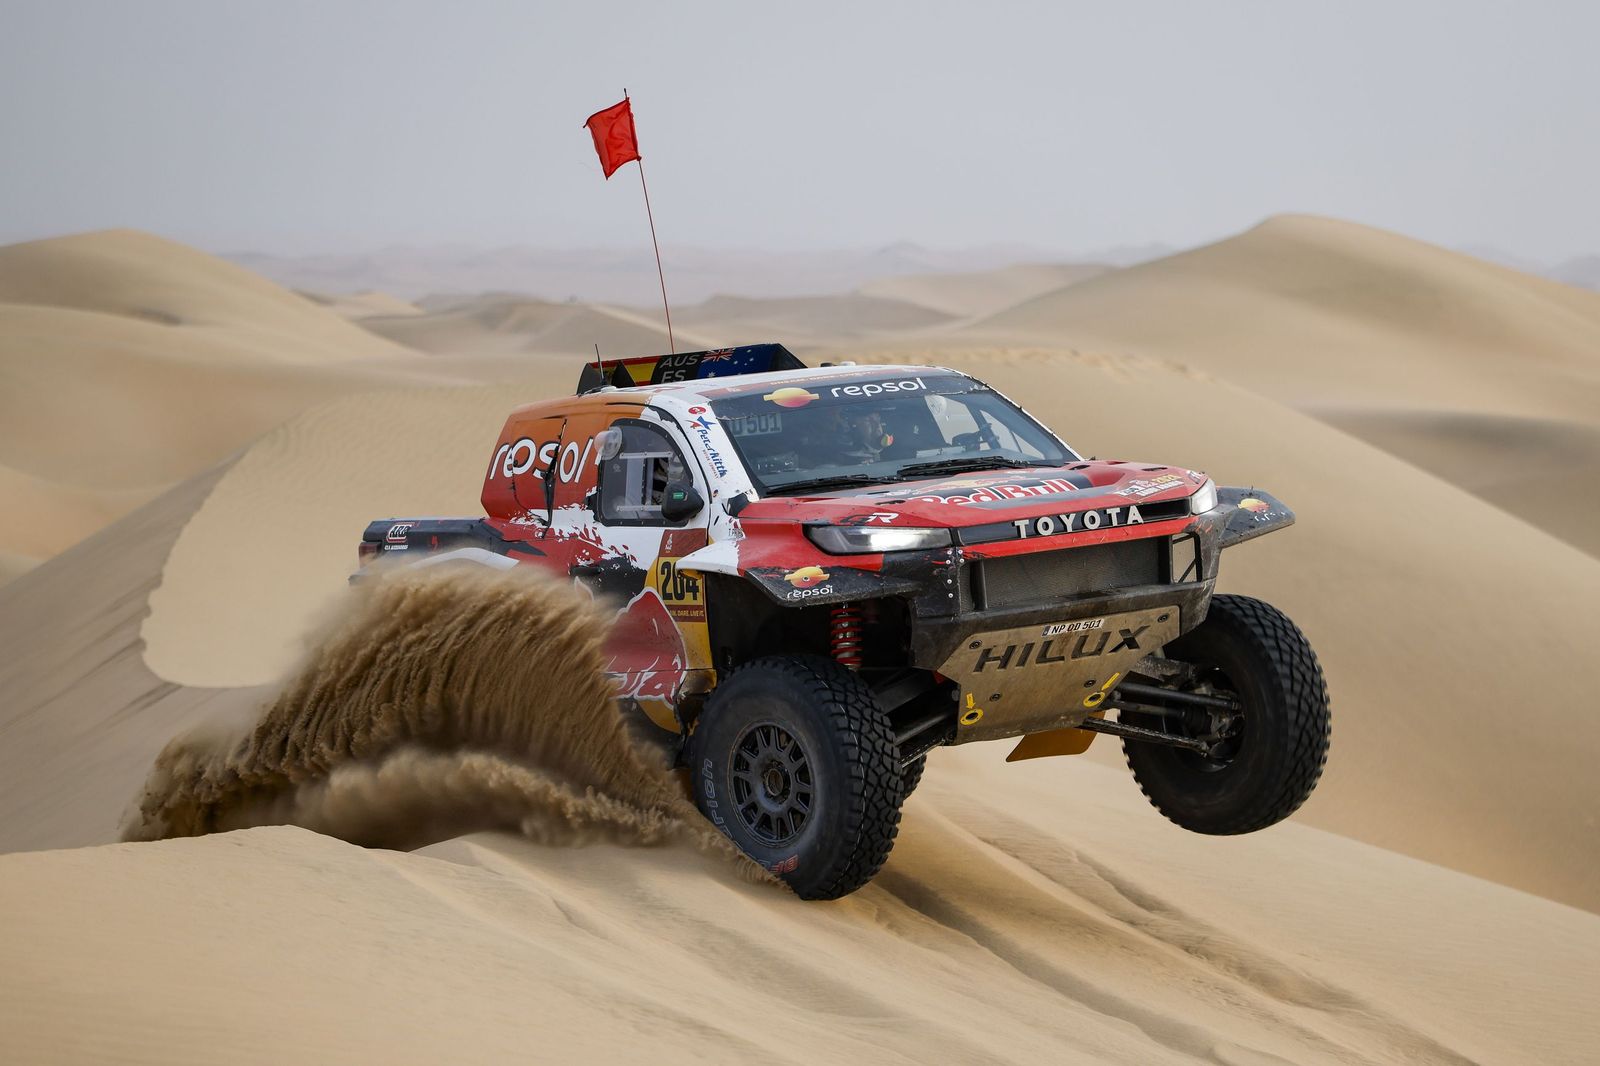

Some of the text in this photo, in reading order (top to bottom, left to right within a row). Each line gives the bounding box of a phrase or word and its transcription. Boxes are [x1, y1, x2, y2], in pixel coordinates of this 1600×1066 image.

[660, 354, 701, 368] AUS
[831, 377, 927, 398] repsol
[995, 478, 1080, 499] Bull
[1014, 505, 1144, 539] TOYOTA
[661, 561, 699, 600] 204
[1051, 624, 1066, 634] NP
[973, 625, 1151, 673] HILUX
